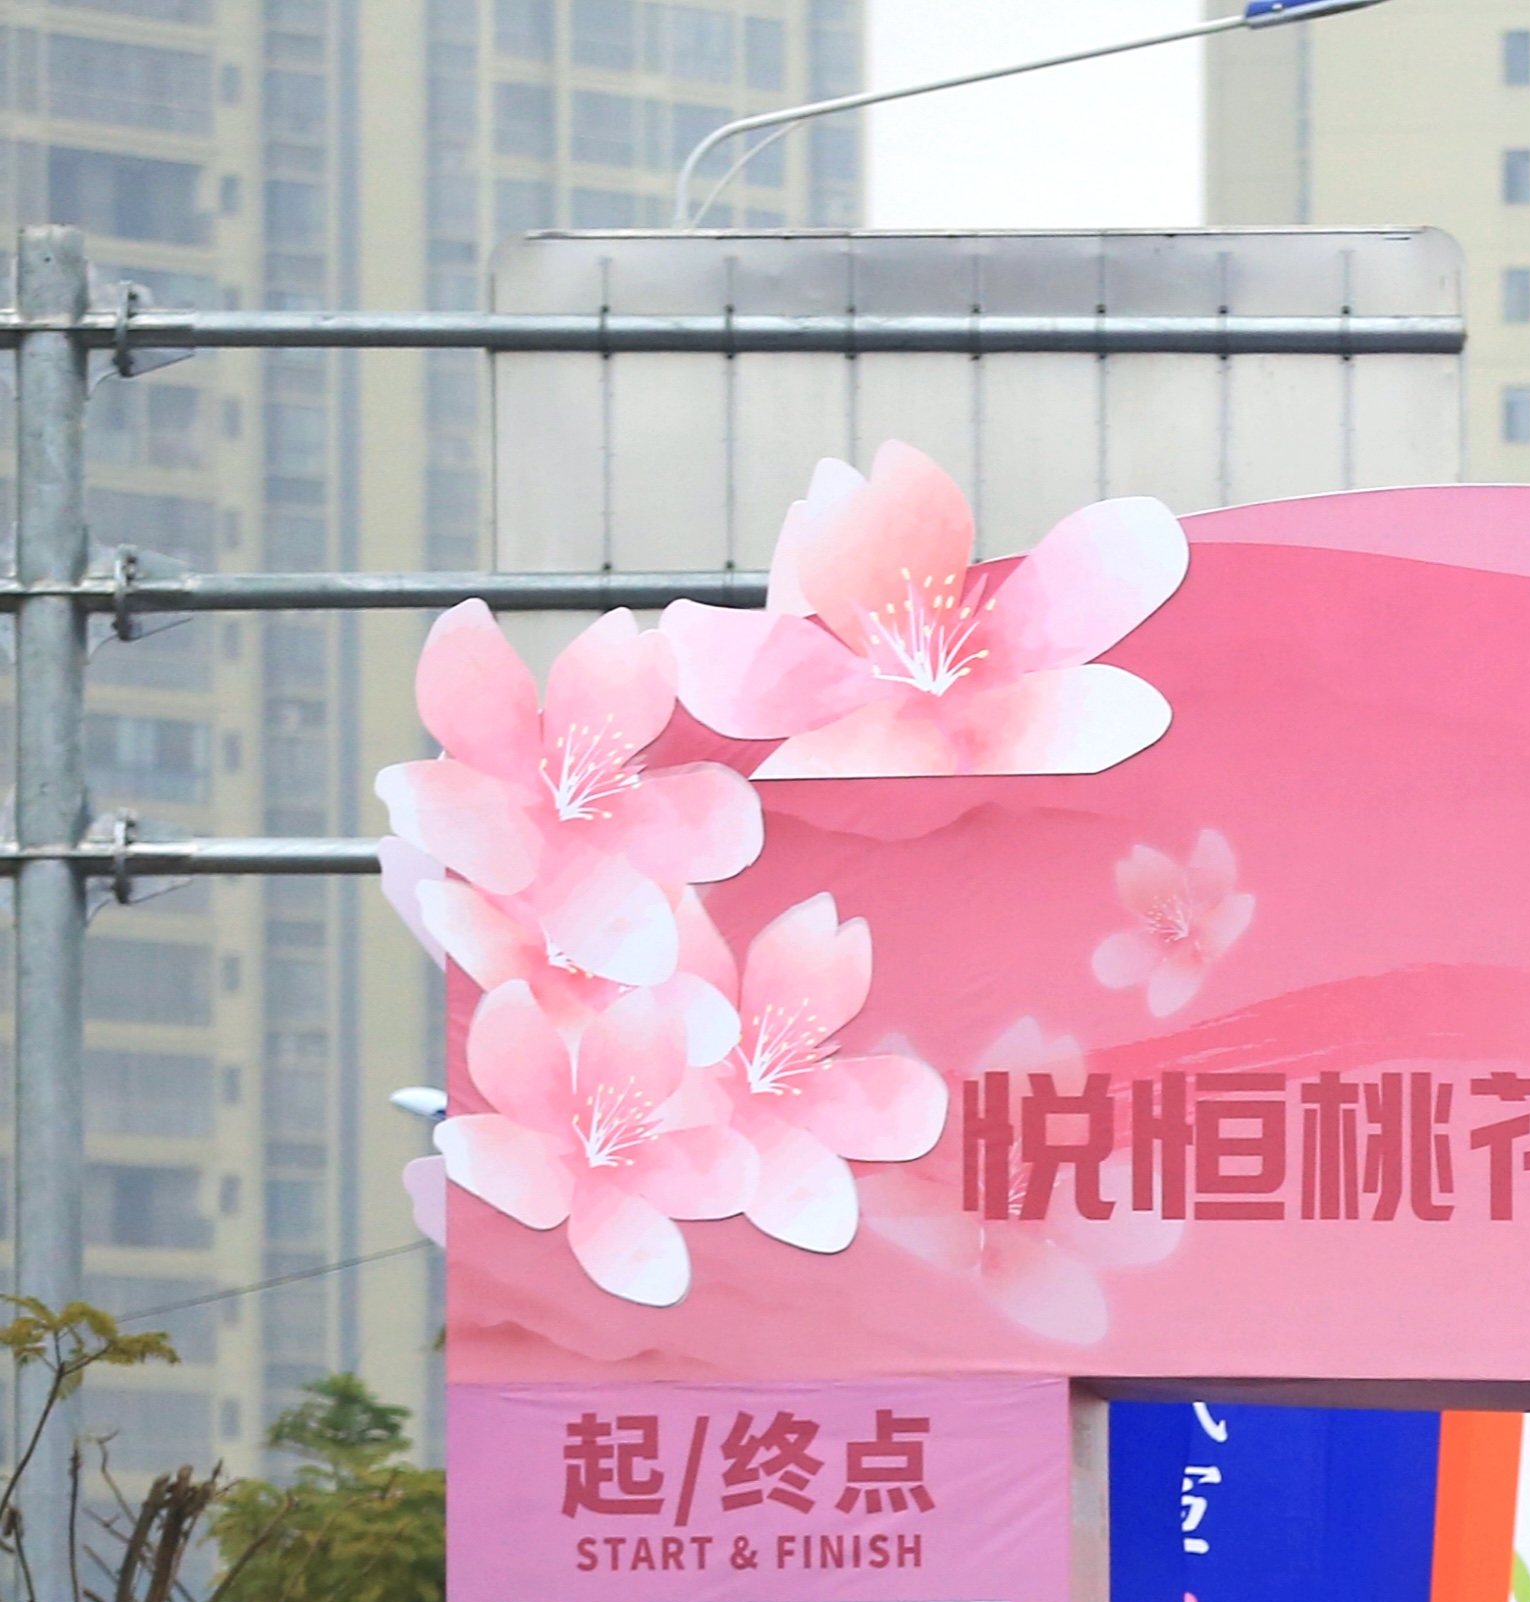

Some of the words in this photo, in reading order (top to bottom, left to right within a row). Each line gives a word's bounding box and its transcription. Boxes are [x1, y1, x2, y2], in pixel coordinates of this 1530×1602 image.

[561, 1408, 937, 1527] 起/终点
[576, 1536, 714, 1572] START
[729, 1536, 759, 1570] &
[777, 1533, 923, 1570] FINISH
